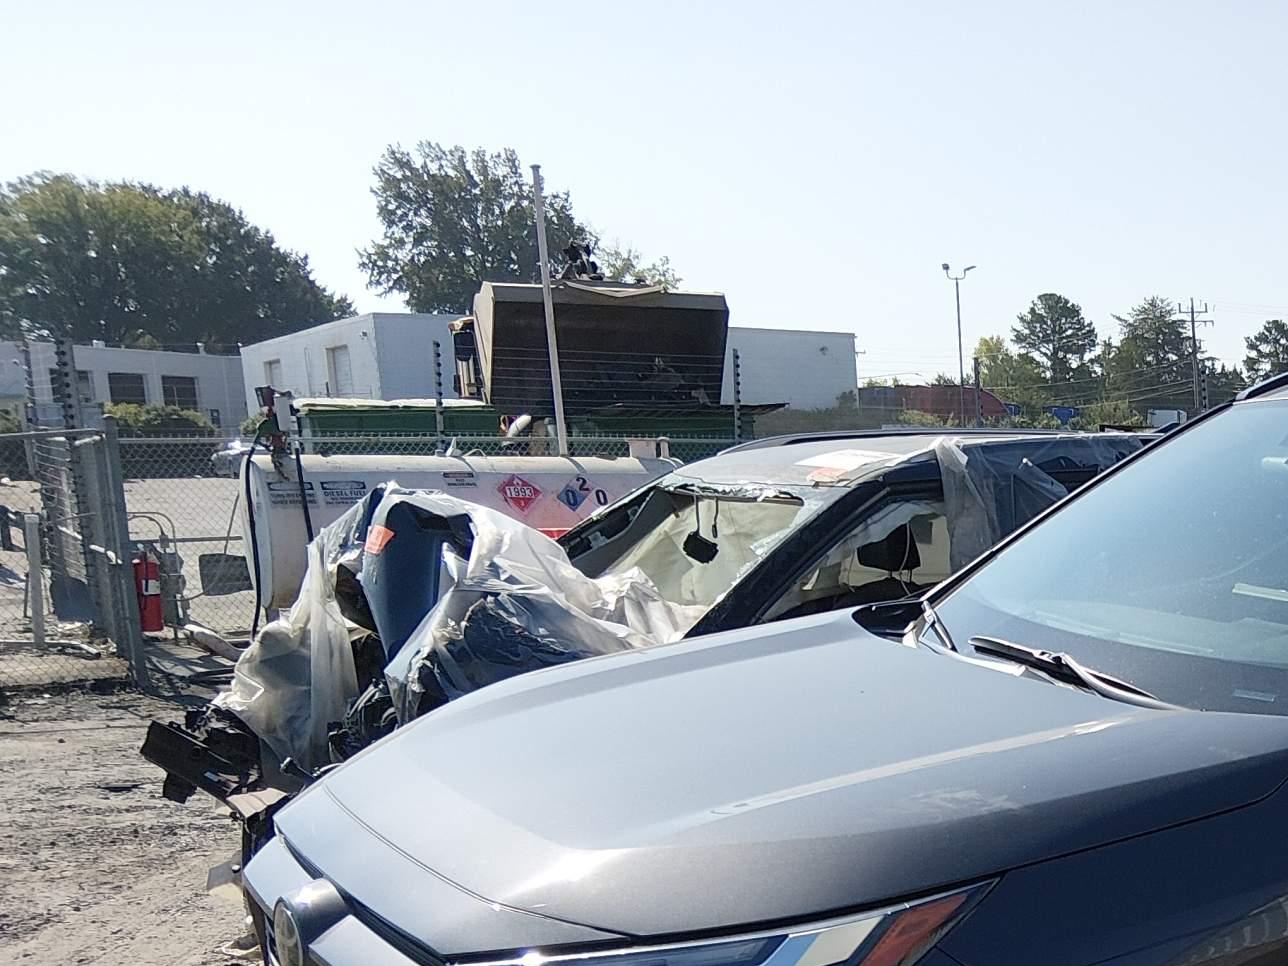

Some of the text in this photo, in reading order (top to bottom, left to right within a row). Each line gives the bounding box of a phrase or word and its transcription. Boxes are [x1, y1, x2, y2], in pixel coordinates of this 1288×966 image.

[576, 476, 590, 491] 2
[507, 487, 533, 497] 1993
[565, 489, 577, 507] 0
[595, 489, 608, 506] 0
